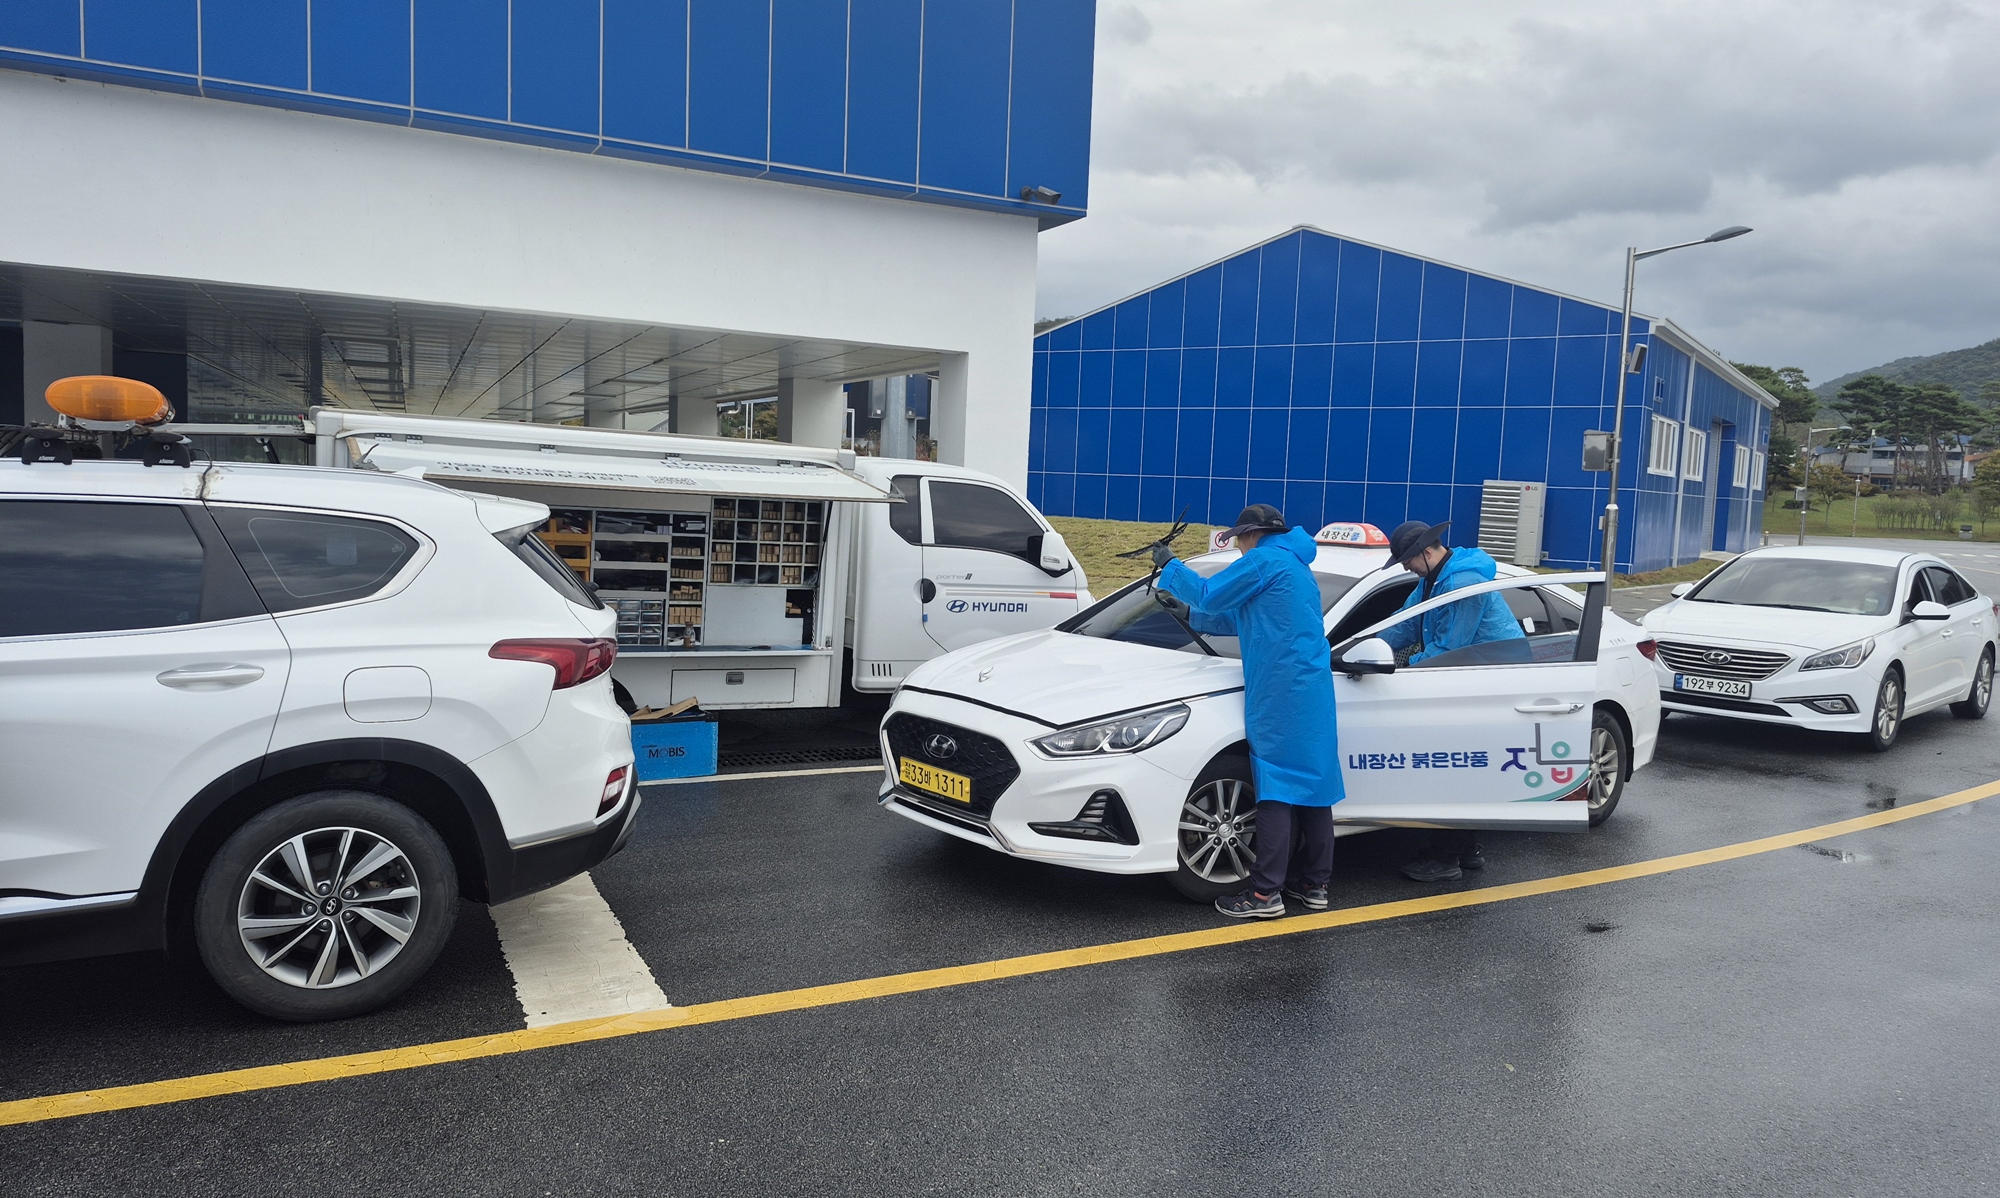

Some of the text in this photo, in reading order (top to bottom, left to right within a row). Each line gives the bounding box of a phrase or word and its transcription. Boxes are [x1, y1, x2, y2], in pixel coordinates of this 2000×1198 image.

[972, 602, 1028, 613] HYUNDAI
[1685, 677, 1714, 691] 192부
[1717, 681, 1746, 695] 9234
[648, 746, 685, 759] MOBIS
[1349, 753, 1407, 770] 내장산
[1411, 750, 1489, 769] 붉은단풍
[911, 764, 931, 786] 33바
[935, 772, 964, 797] 1311
